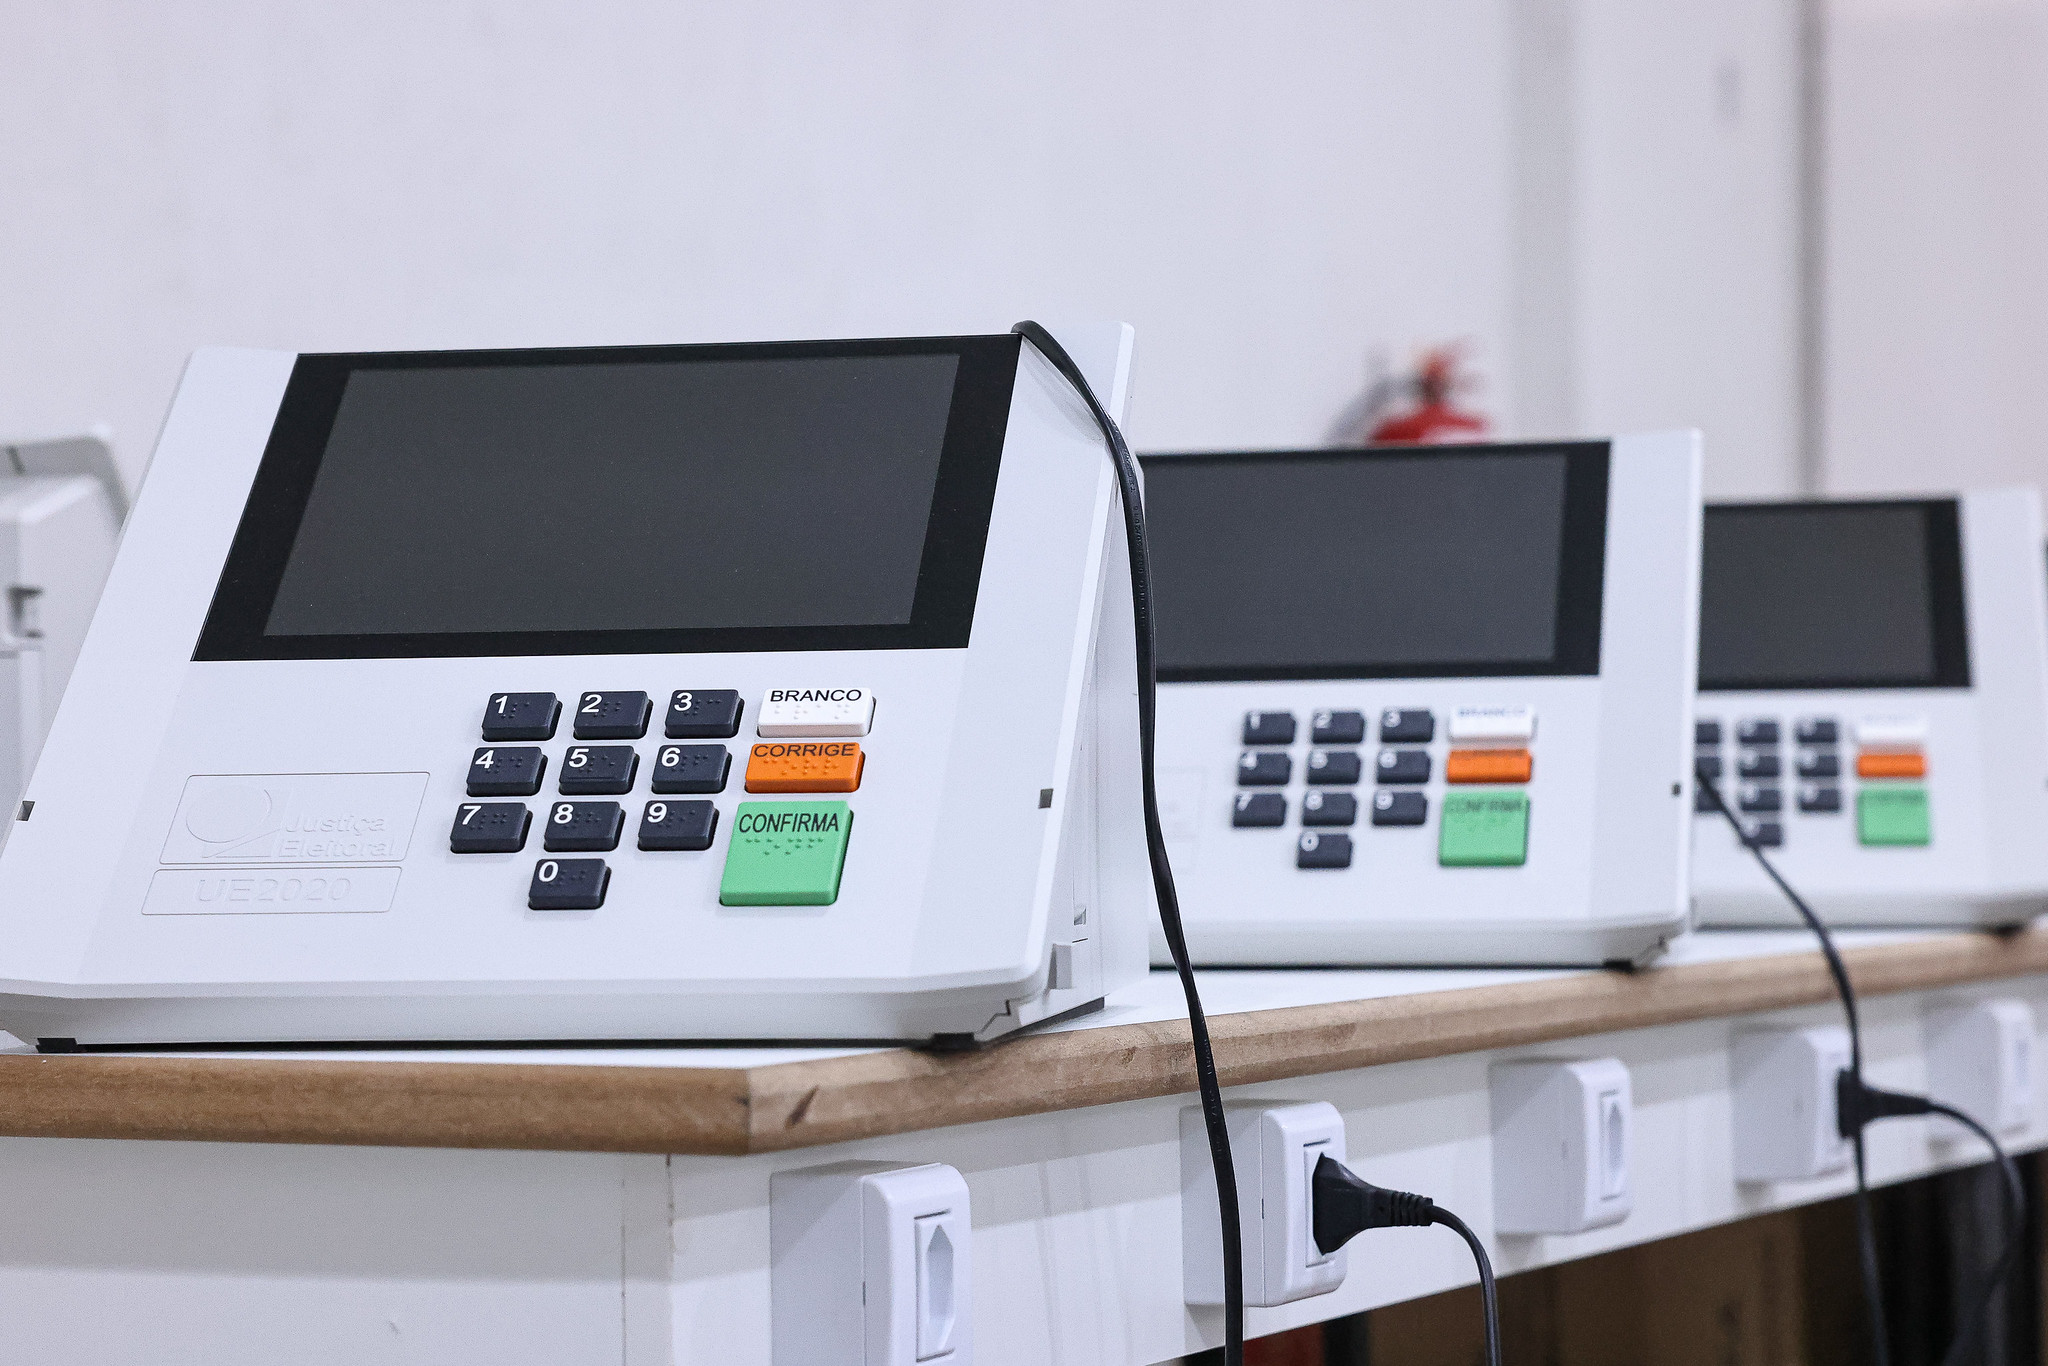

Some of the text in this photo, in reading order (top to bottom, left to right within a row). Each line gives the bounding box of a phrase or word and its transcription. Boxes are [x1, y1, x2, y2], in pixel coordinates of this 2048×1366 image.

[495, 695, 508, 714] 1
[581, 694, 602, 713] 2
[673, 692, 693, 712] 3
[770, 689, 862, 702] BRANCO
[474, 749, 495, 769] 4
[568, 748, 589, 768] 5
[661, 747, 681, 767] 6
[753, 743, 856, 758] CORRIGE
[462, 805, 482, 826] 7
[553, 803, 574, 824] 8
[647, 802, 668, 823] 9
[738, 812, 840, 833] CONFIRMA
[285, 814, 386, 836] Justiça
[278, 839, 395, 859] Eleitoral
[538, 860, 559, 882] 0
[195, 877, 351, 903] UE2020
